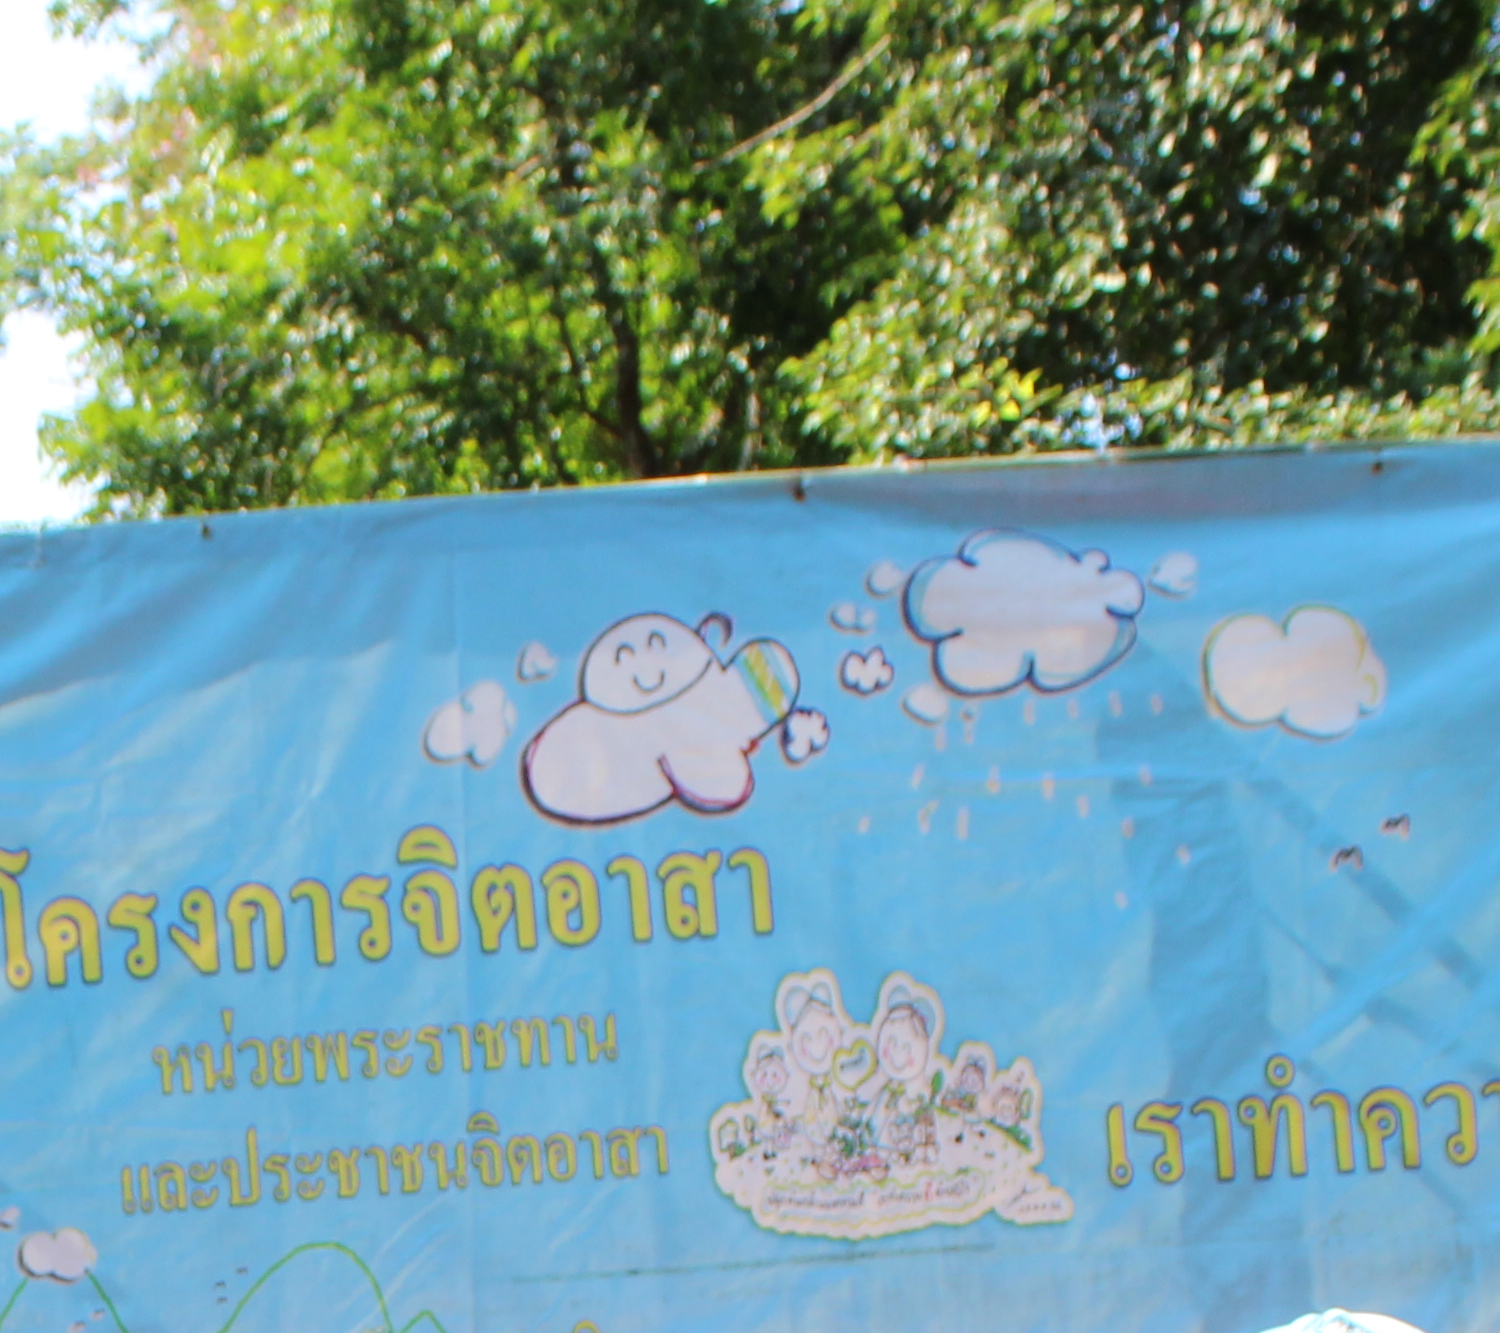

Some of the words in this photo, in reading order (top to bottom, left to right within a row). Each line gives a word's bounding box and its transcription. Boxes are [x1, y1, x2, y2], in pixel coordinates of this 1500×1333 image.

[150, 1008, 620, 1098] หน่วยพระราชทาน
[119, 1110, 672, 1218] และประชาชนจิตอาสา
